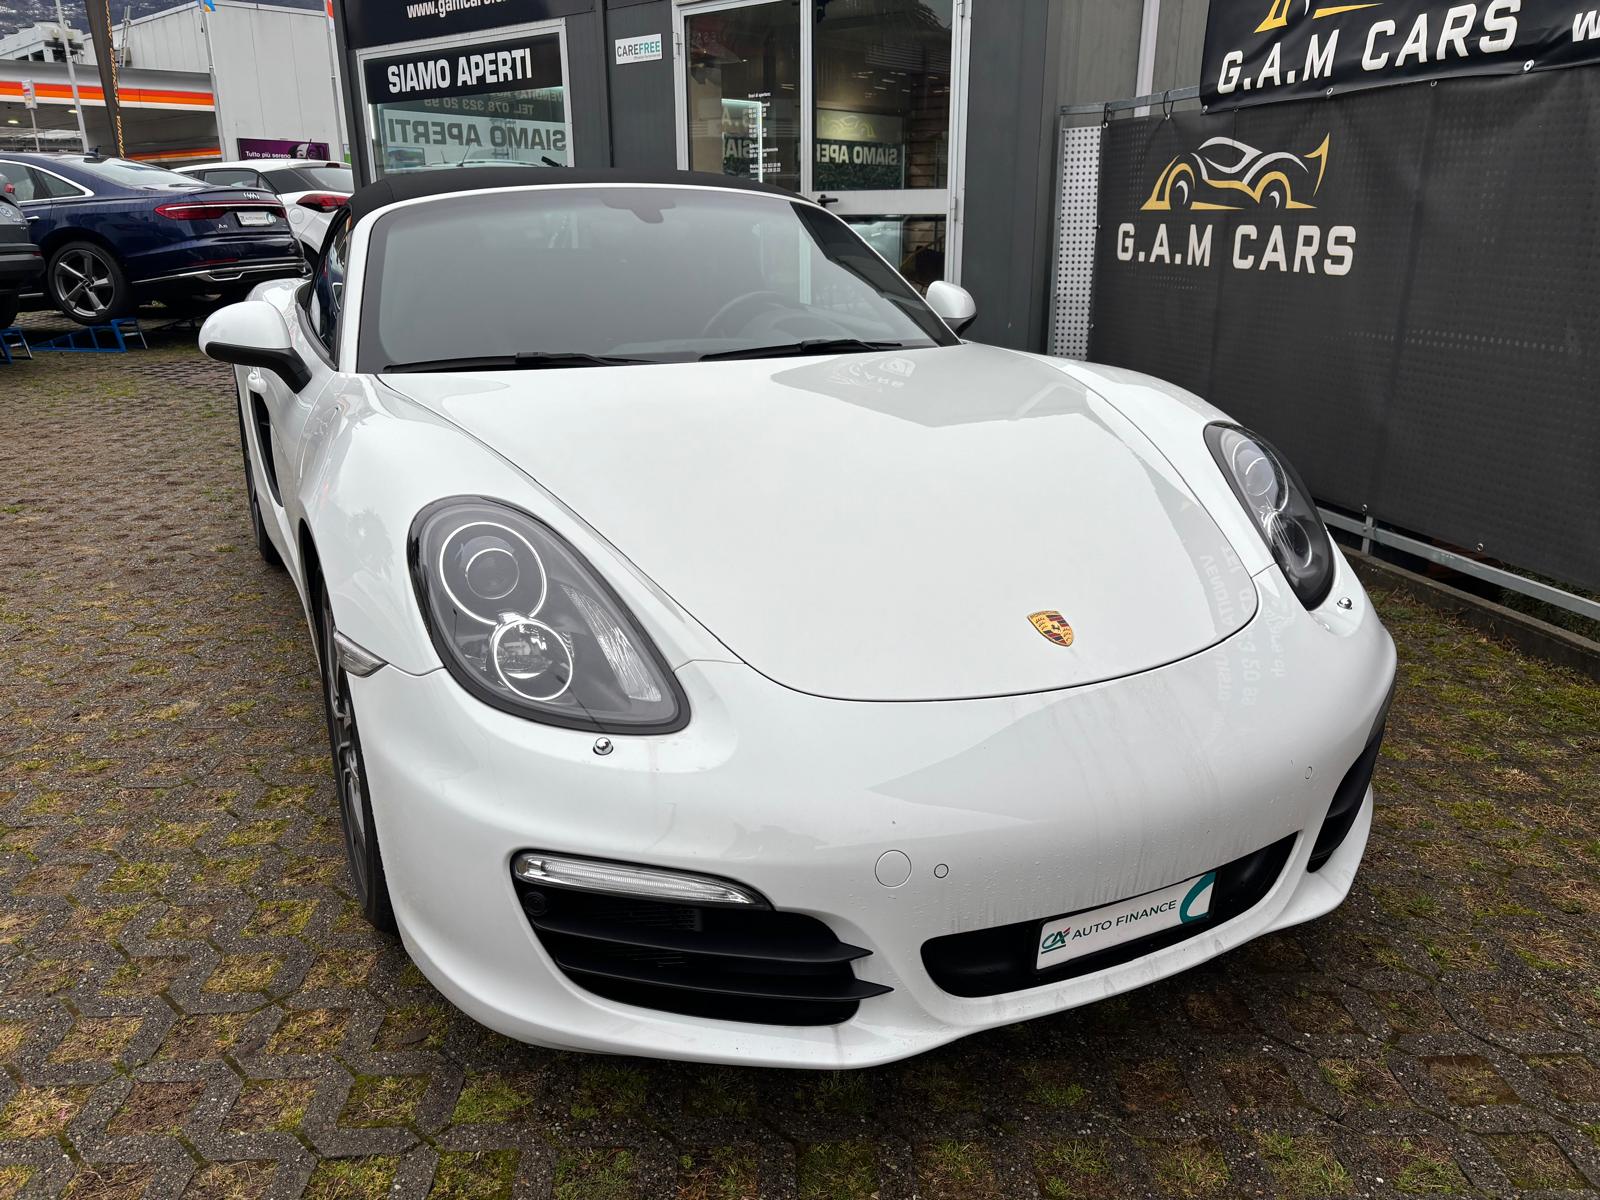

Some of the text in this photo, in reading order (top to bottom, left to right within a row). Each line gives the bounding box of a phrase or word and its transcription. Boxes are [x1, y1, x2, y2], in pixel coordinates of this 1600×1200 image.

[616, 40, 661, 57] CAREFREE
[1217, 0, 1522, 94] G.A.M CARS
[387, 48, 532, 94] SIAMO APERTI
[245, 150, 261, 158] Tutto
[1116, 223, 1357, 276] G.A.M CARS
[1072, 920, 1112, 940] AUTO
[1115, 899, 1177, 927] FINANCE
